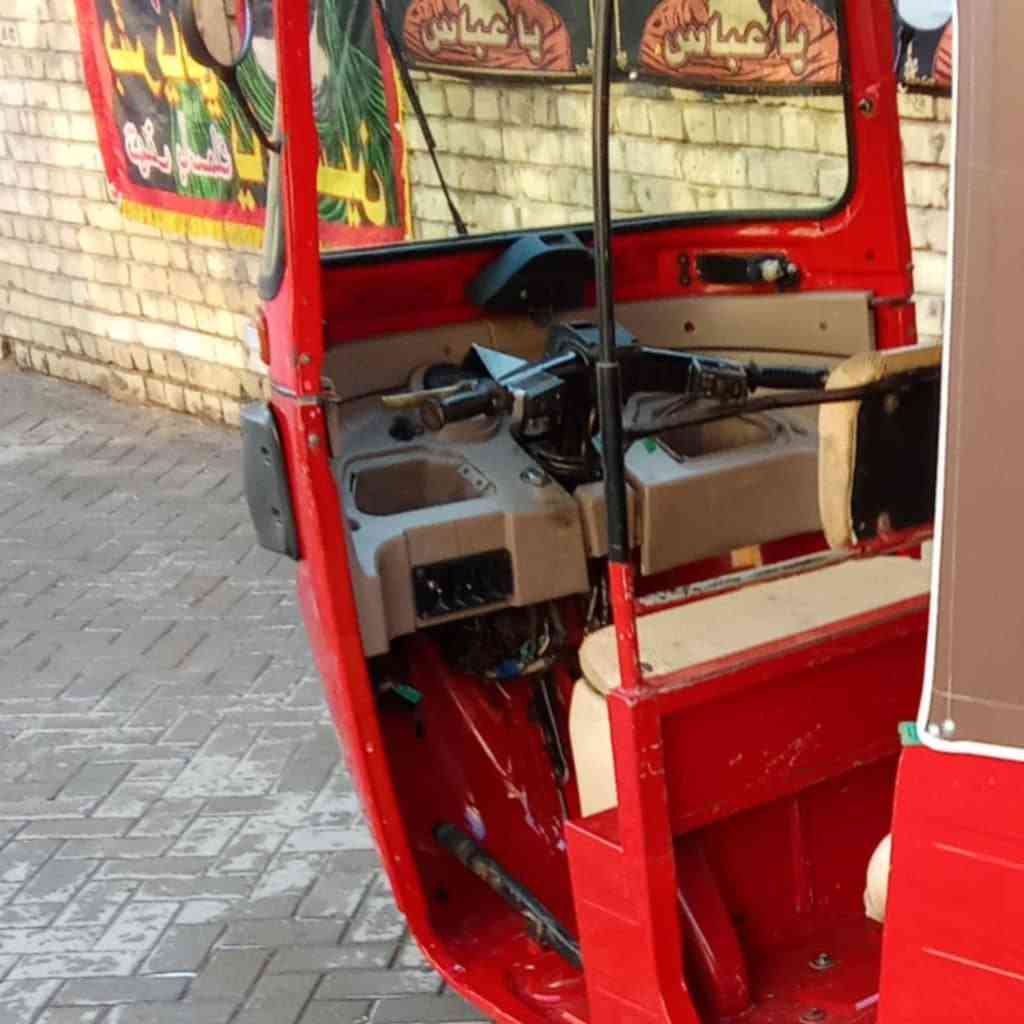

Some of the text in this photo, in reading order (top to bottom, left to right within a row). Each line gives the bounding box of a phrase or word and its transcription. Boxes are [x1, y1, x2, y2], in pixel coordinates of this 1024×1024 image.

[421, 4, 542, 64] يا عباس
[663, 11, 809, 75] يا عباس
